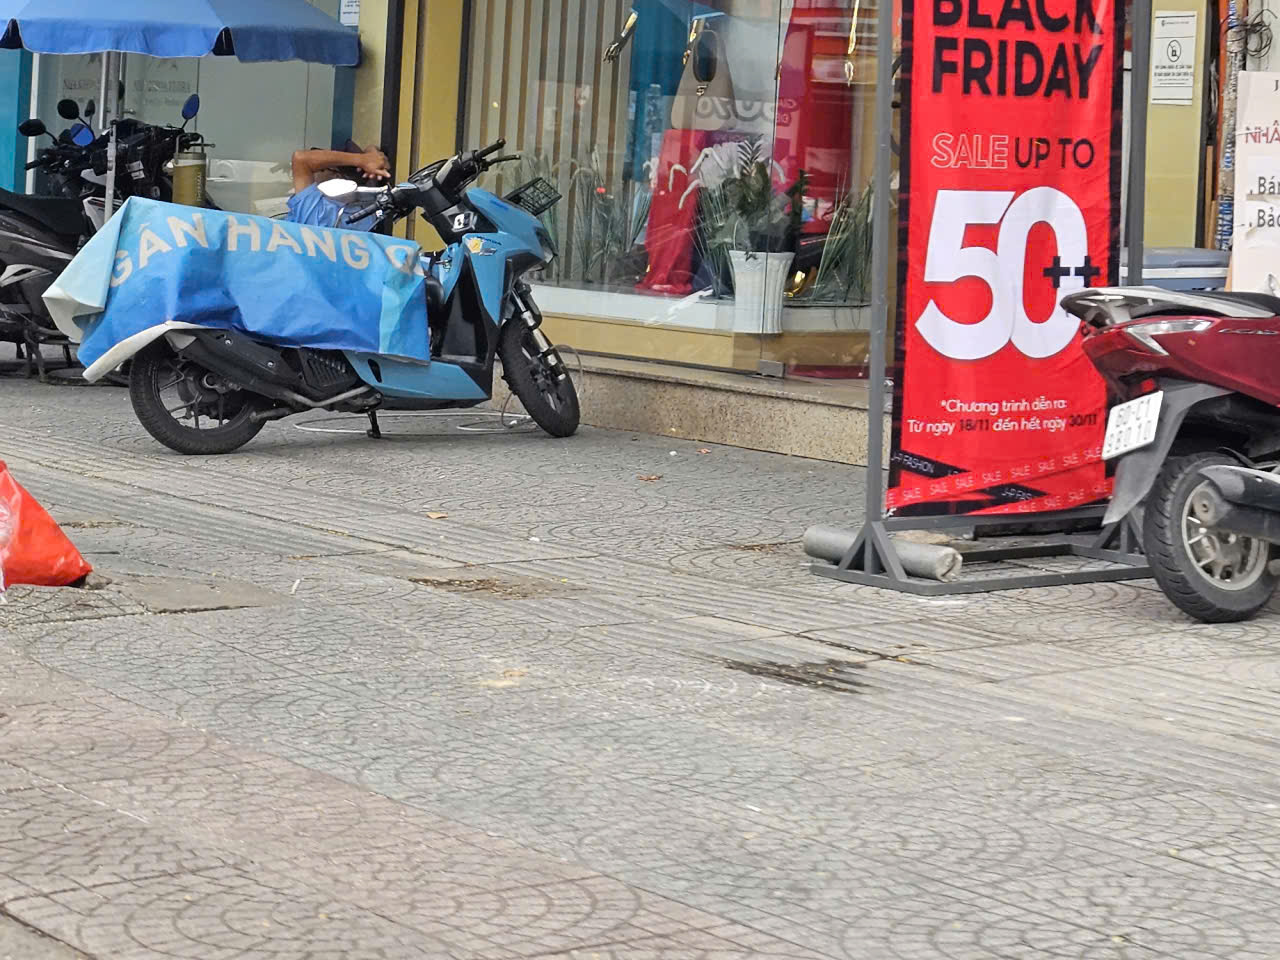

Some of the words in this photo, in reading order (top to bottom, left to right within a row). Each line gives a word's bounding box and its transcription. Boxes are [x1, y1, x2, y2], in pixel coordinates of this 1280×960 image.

[931, 35, 1105, 100] FRIDAY
[930, 132, 1009, 170] SALE
[1014, 136, 1051, 170] UP
[1057, 137, 1096, 170] TO
